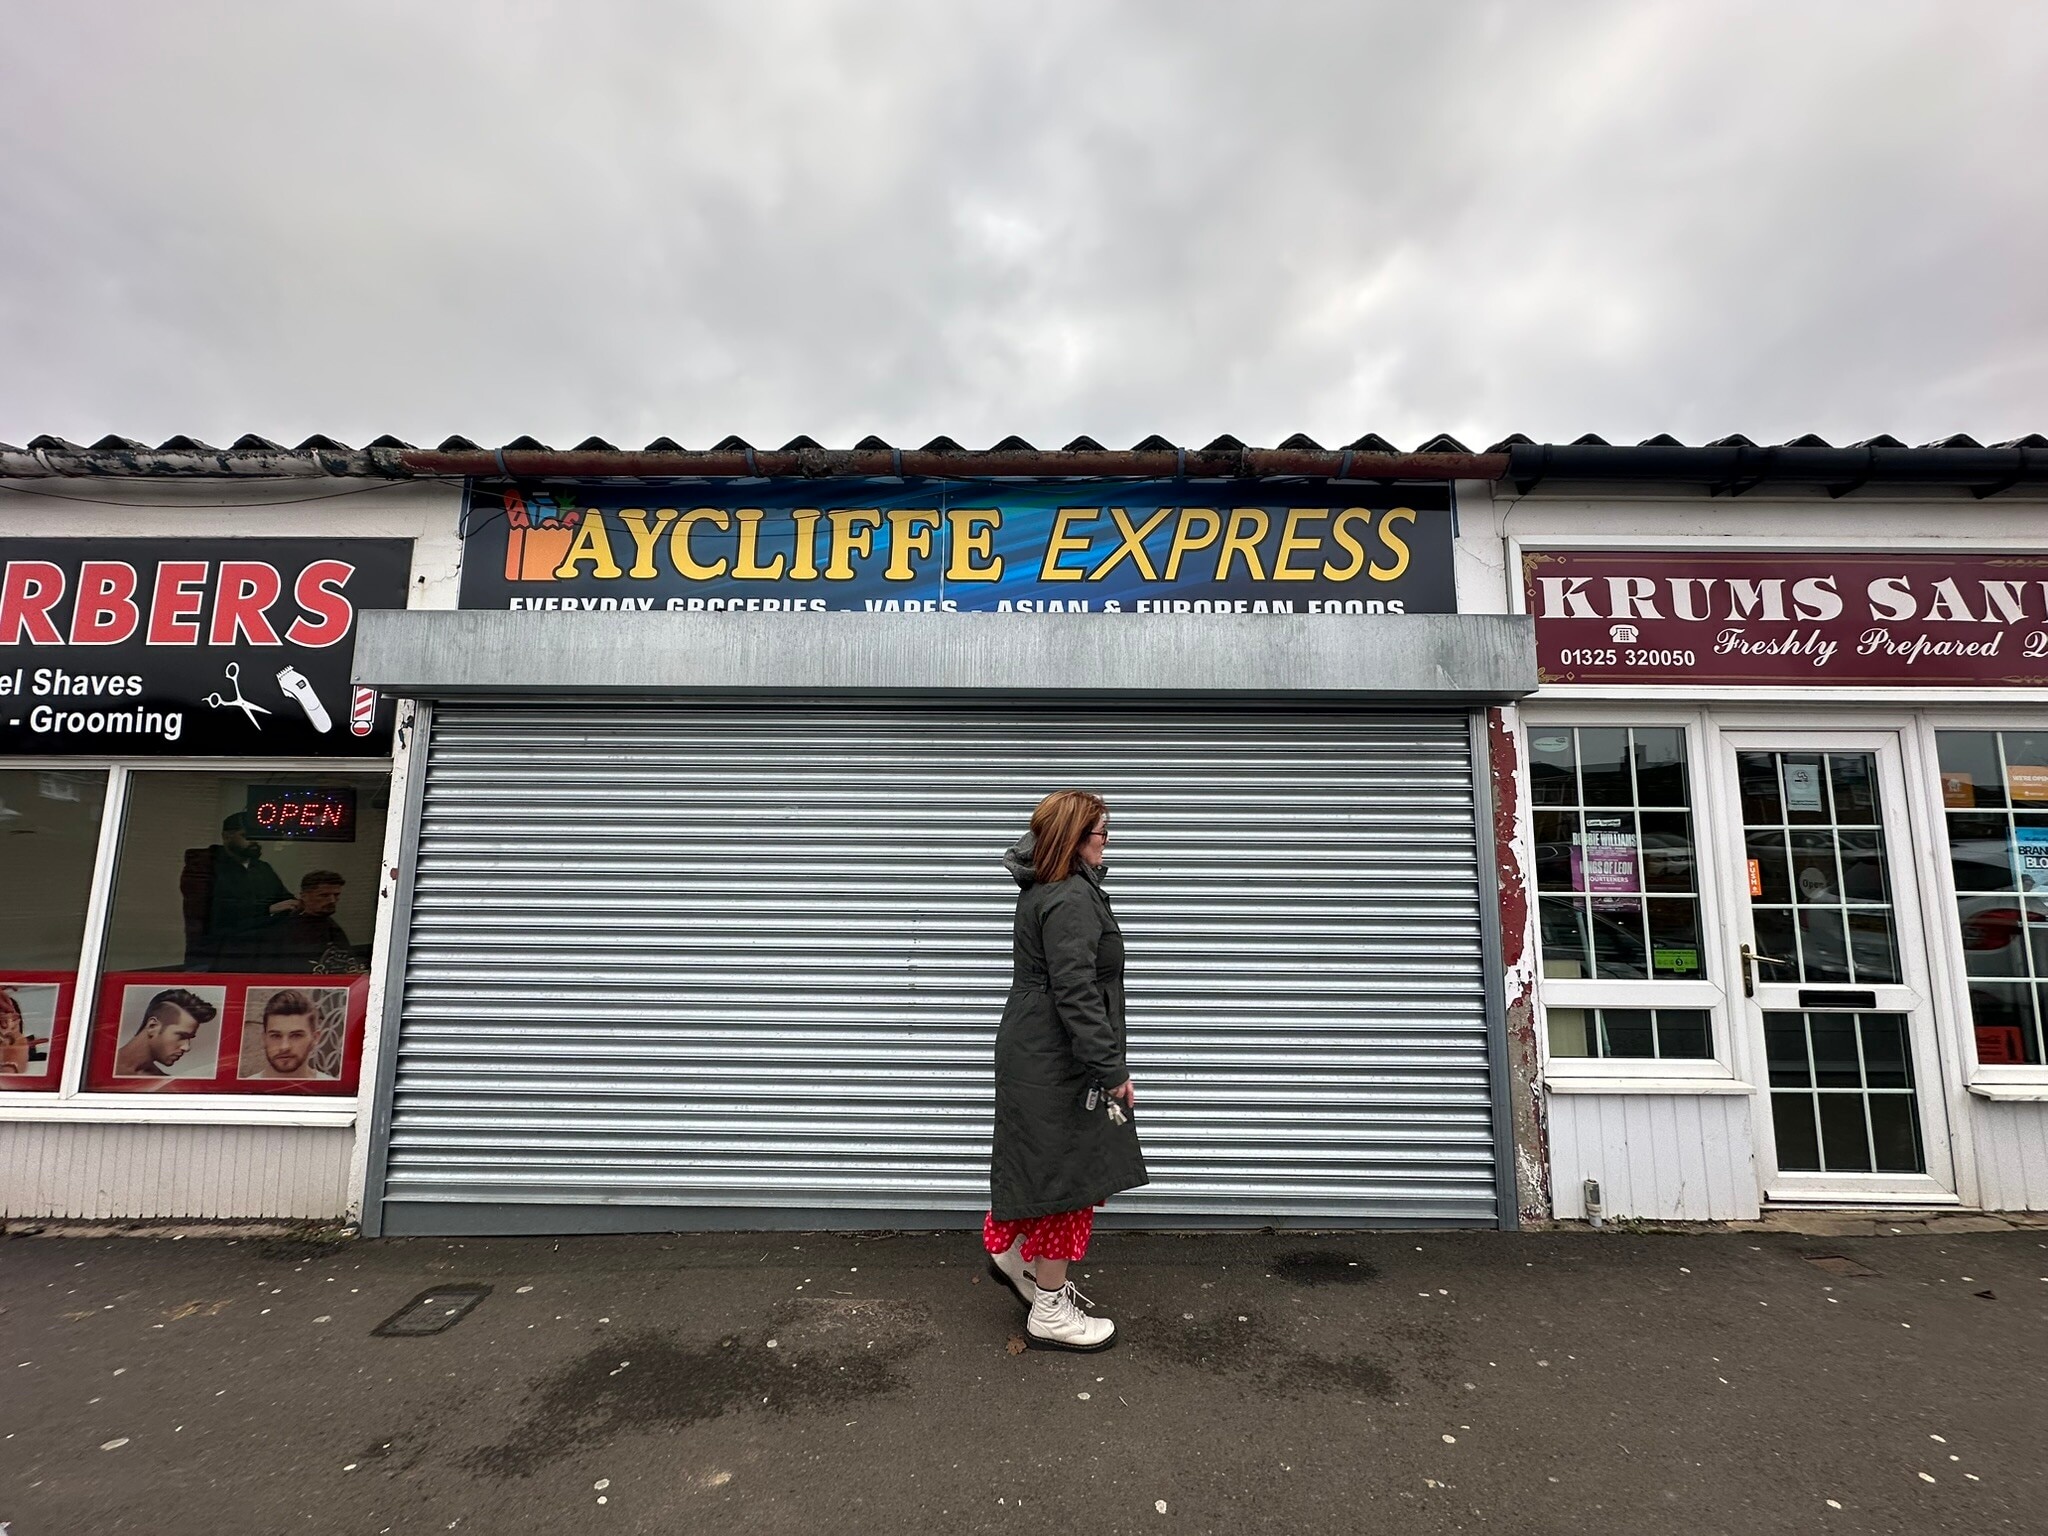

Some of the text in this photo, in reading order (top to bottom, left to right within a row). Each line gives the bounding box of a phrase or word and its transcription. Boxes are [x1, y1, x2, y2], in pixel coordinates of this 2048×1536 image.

[554, 506, 1417, 583] AYCLIFFE EXPRESS
[509, 597, 655, 611] EVERYDAY
[997, 600, 1089, 613] ASIAN
[1536, 573, 2048, 626] KRUMS SAN
[1560, 649, 1696, 666] 01325 320050
[1712, 627, 1839, 667] Freshly
[1856, 628, 2004, 665] Prepared
[32, 668, 143, 696] Shaves
[30, 704, 183, 741] Grooming
[257, 803, 343, 826] OPEN
[1600, 833, 1637, 847] WILLIAMS
[1579, 860, 1633, 875] KNGS OF LEON
